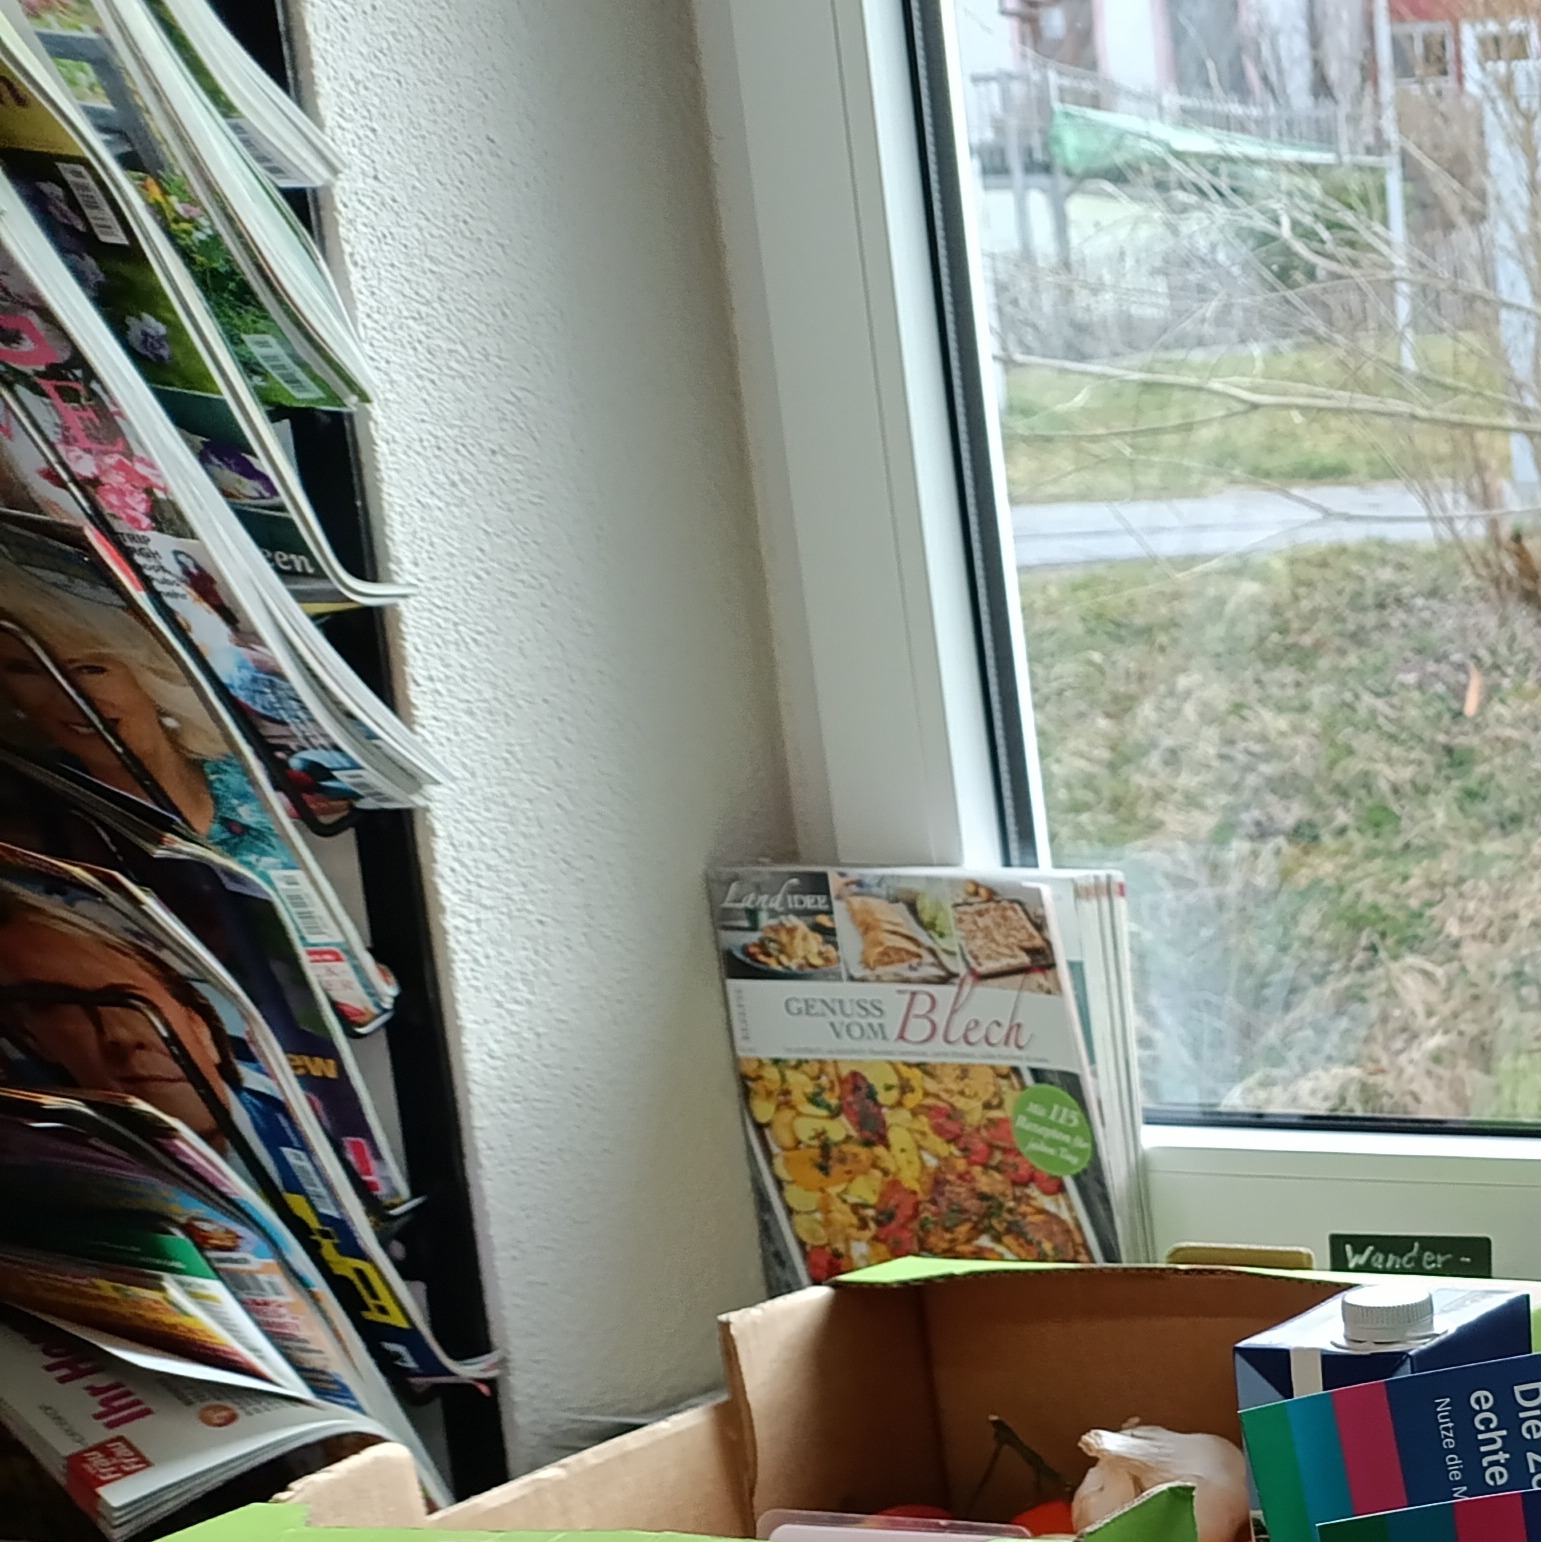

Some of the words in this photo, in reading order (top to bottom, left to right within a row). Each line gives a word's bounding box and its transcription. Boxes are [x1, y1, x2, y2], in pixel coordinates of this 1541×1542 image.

[784, 997, 885, 1018] GENUSS
[829, 1021, 888, 1041] VOM
[893, 966, 1034, 1050] Blech
[1049, 1104, 1079, 1127] 115
[1434, 1397, 1456, 1449] Nutze
[1445, 1454, 1463, 1481] die
[1470, 1390, 1510, 1486] echte
